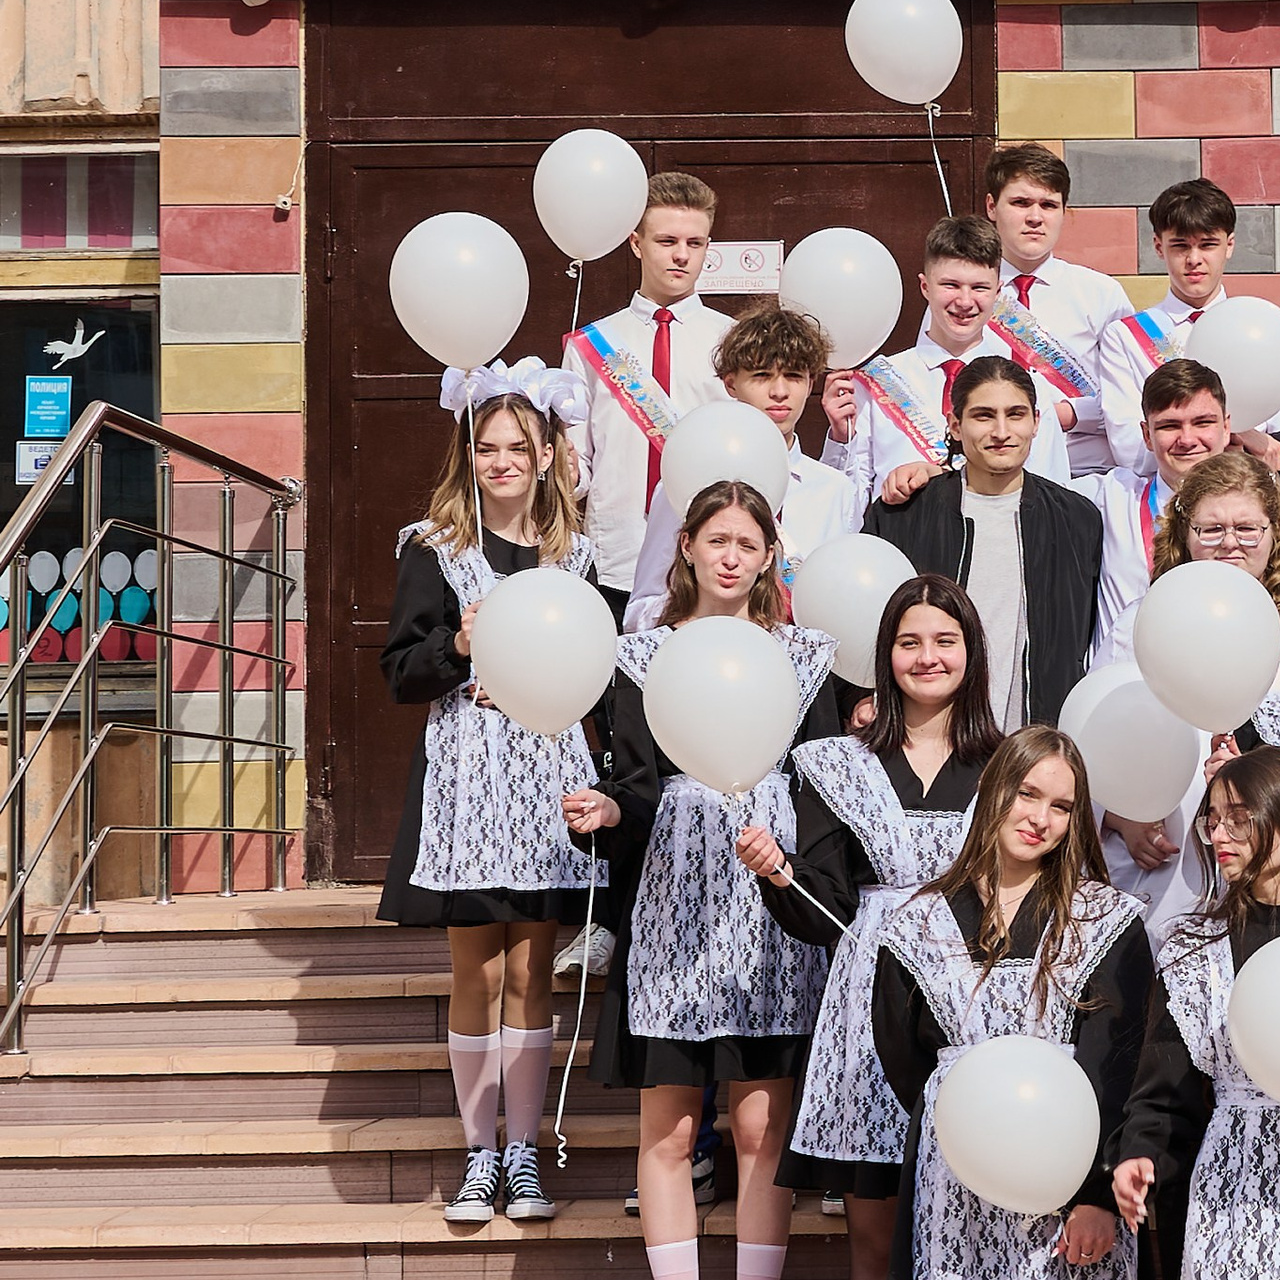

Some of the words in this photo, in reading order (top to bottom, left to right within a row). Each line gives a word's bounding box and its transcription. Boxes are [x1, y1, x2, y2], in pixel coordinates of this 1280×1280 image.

[704, 280, 764, 288] ЗАПРЕЩЕНО
[29, 381, 68, 395] ПОЛИЦИЯ
[28, 445, 59, 453] ВЕДЕТС
